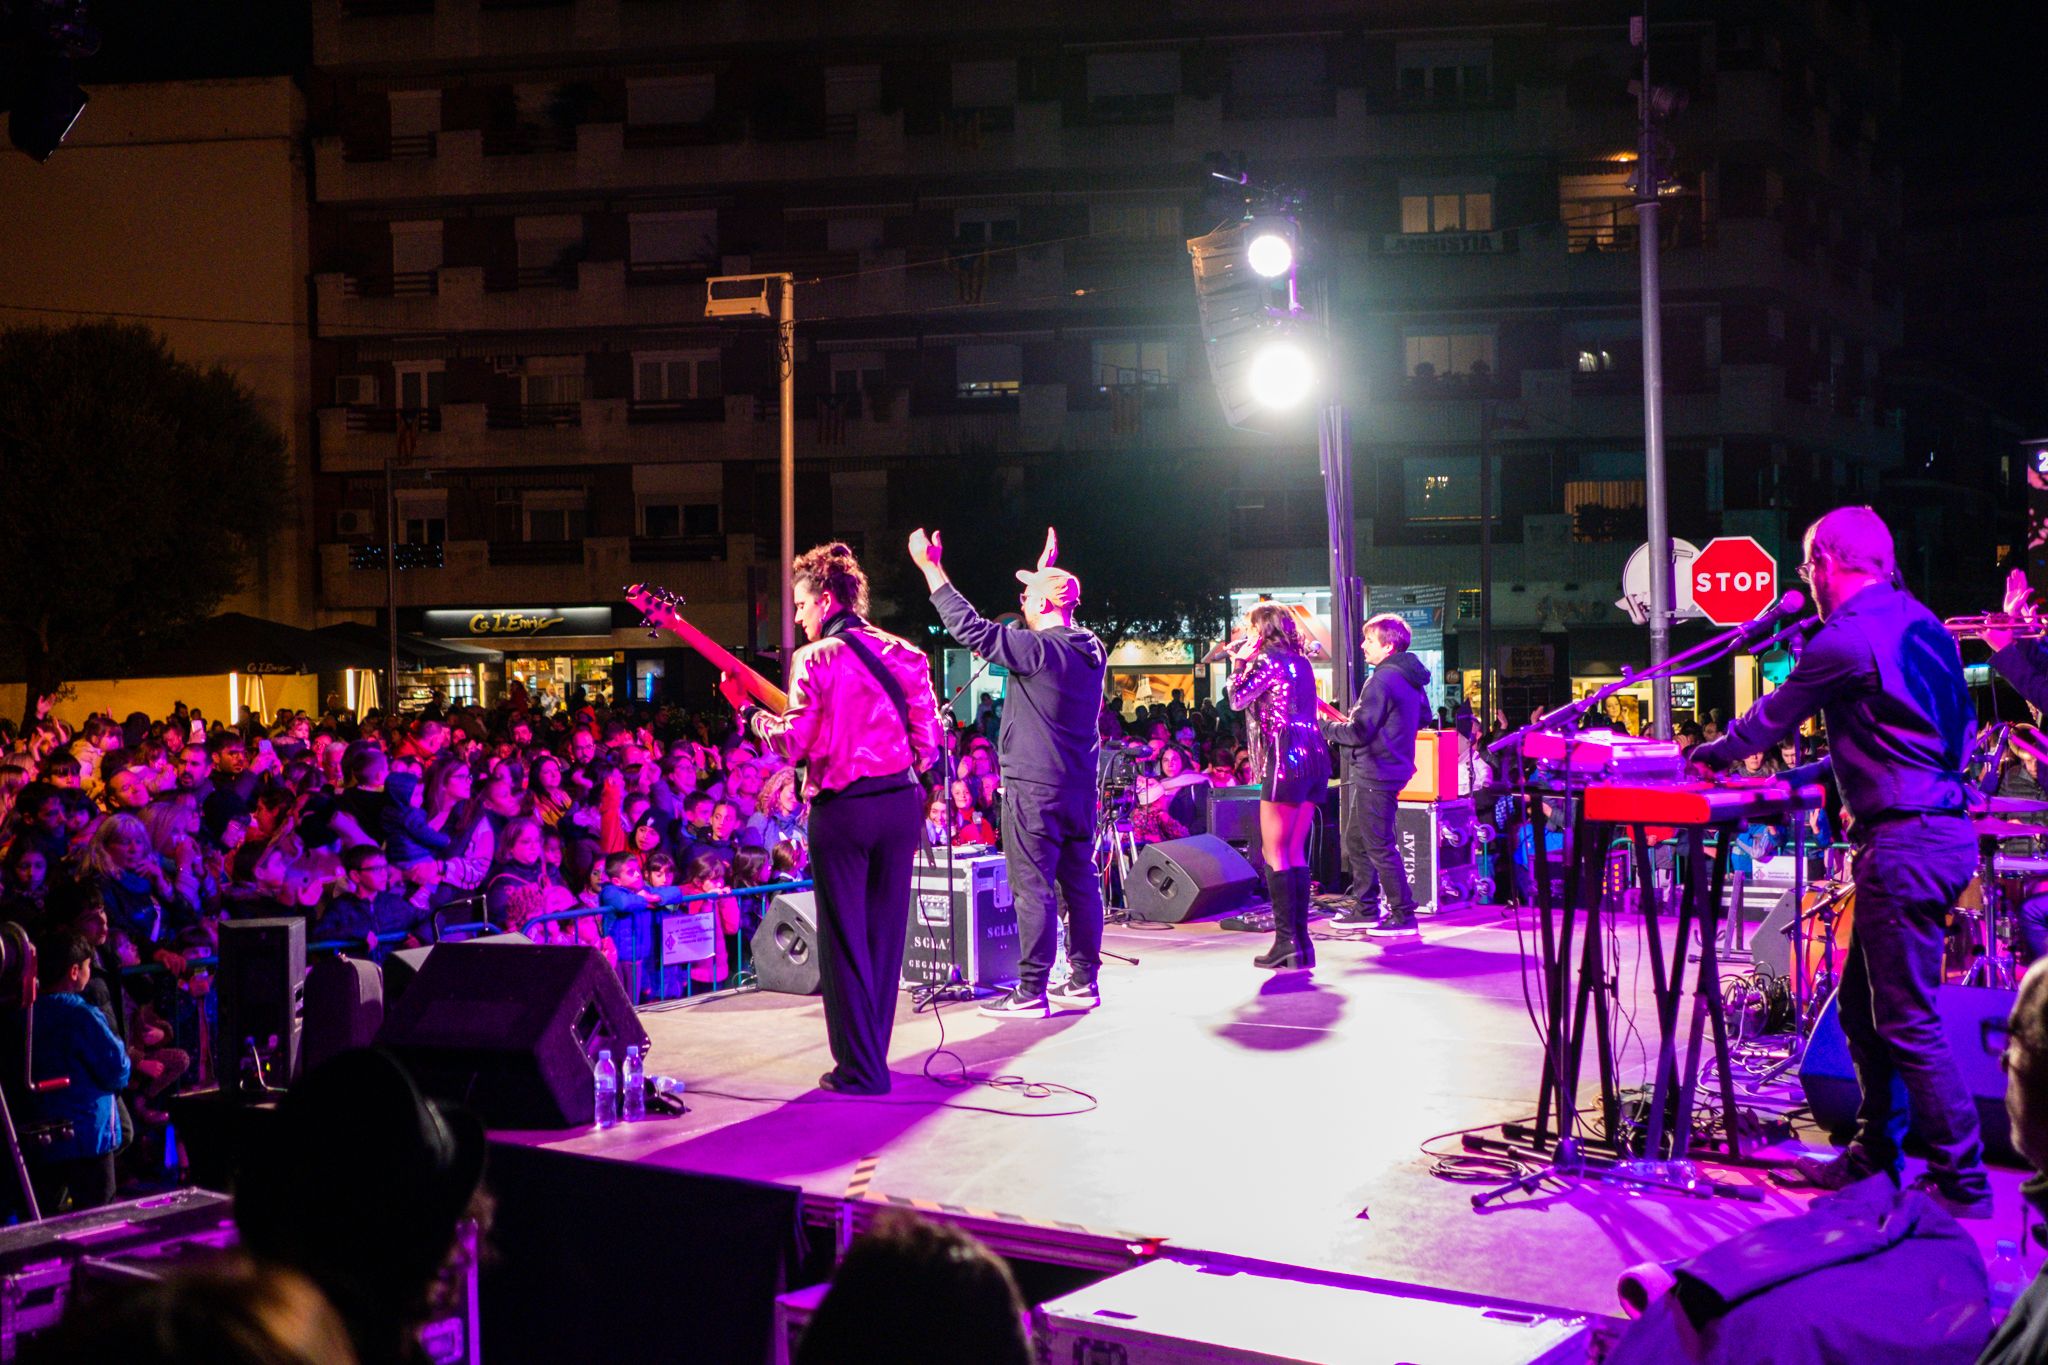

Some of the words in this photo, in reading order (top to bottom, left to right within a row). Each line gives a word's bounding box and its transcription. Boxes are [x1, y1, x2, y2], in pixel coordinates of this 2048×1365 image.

[1696, 572, 1771, 592] STOP
[469, 613, 490, 634] Ca
[1403, 831, 1415, 884] SCLAT
[987, 923, 1018, 939] SCLAT
